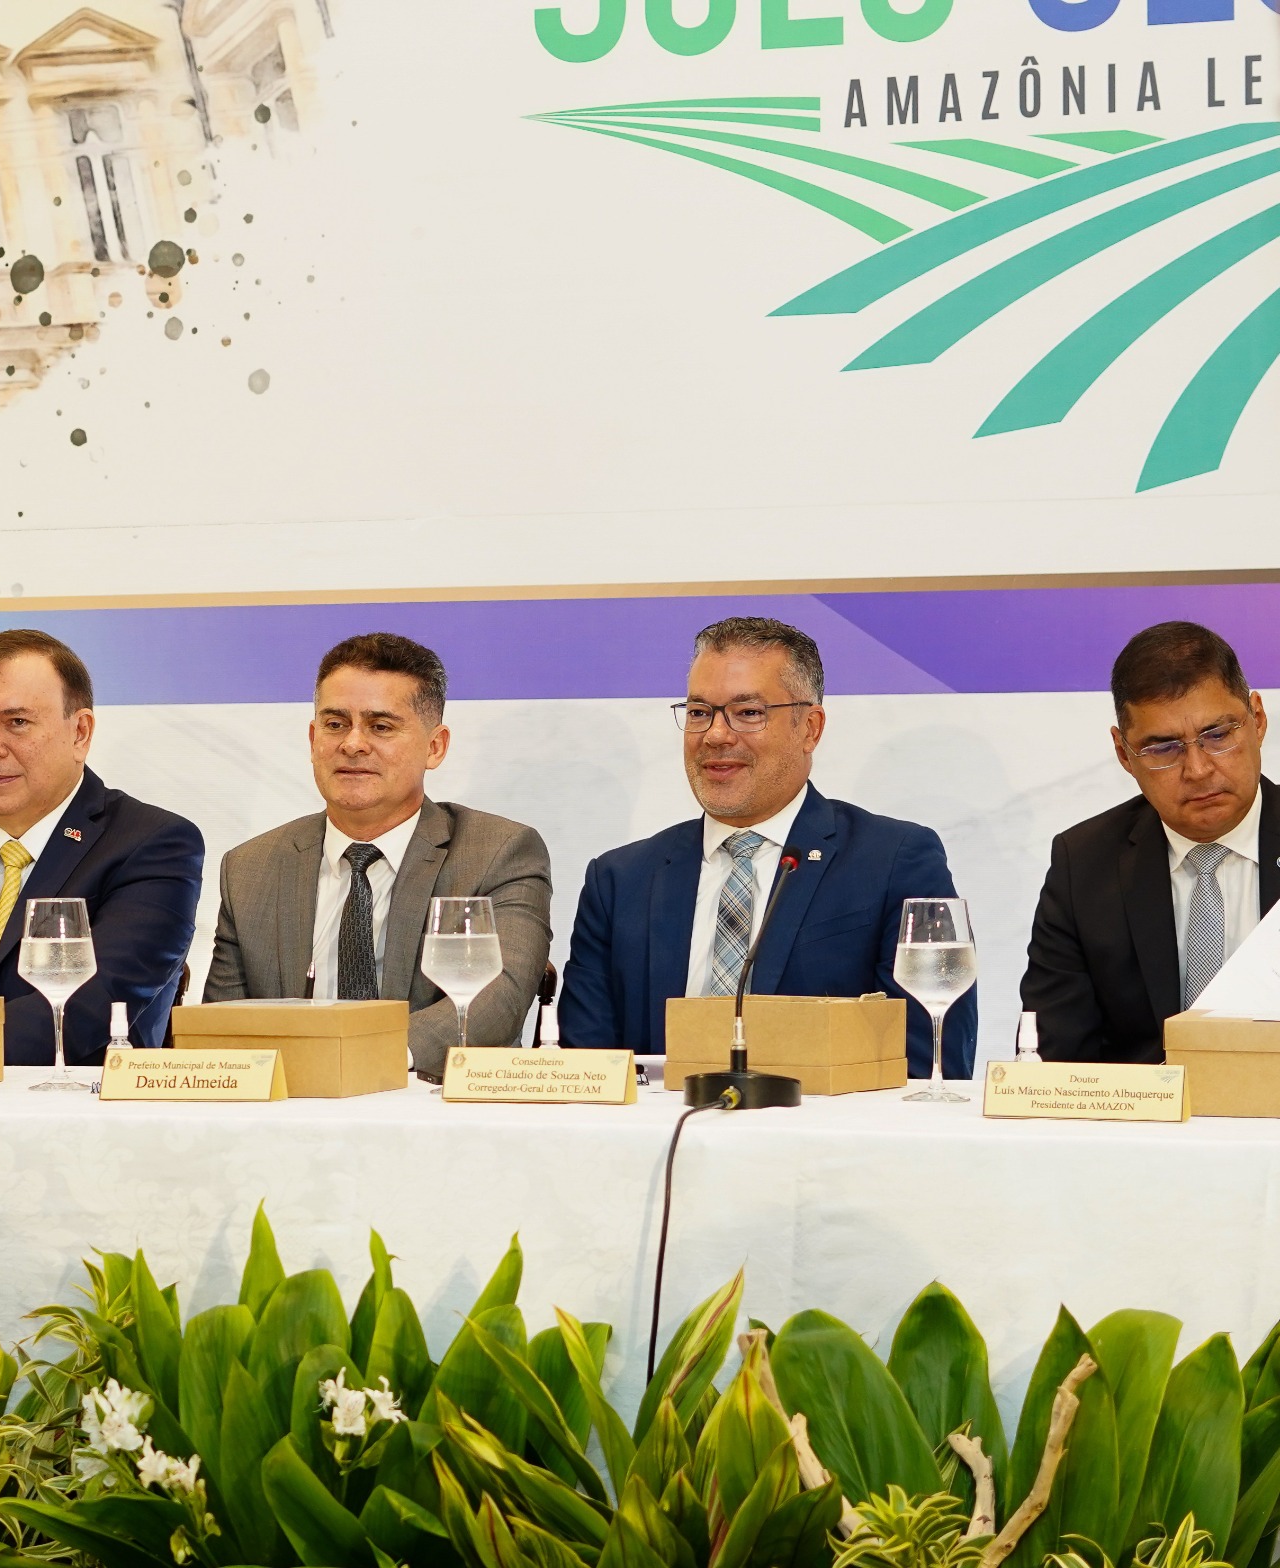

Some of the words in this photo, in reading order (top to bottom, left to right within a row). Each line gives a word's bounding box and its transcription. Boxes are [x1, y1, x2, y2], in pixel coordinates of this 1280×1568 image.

[843, 56, 1161, 128] AMAZÔNIA
[1207, 54, 1263, 108] LE
[128, 1062, 160, 1070] Prefeito
[162, 1062, 204, 1071] Municipal
[219, 1062, 251, 1070] Manaus
[511, 1057, 564, 1066] Conselheiro
[465, 1069, 492, 1078] Josué
[495, 1070, 533, 1080] Cláudio
[536, 1071, 548, 1080] de
[551, 1072, 580, 1080] Souza
[583, 1072, 607, 1080] Neto
[1070, 1075, 1099, 1084] Doutor
[135, 1076, 176, 1089] David
[179, 1075, 238, 1089] Almeida
[467, 1083, 543, 1094] Corregedor-Geral
[546, 1084, 558, 1093] do
[561, 1085, 601, 1093] TCE/AM
[1017, 1086, 1052, 1096] Márcio
[1054, 1087, 1110, 1097] Nascimento
[1112, 1089, 1174, 1101] Albuquerque
[1031, 1100, 1075, 1110] Presidente
[1076, 1101, 1087, 1110] da
[1088, 1102, 1135, 1111] AMAZON
